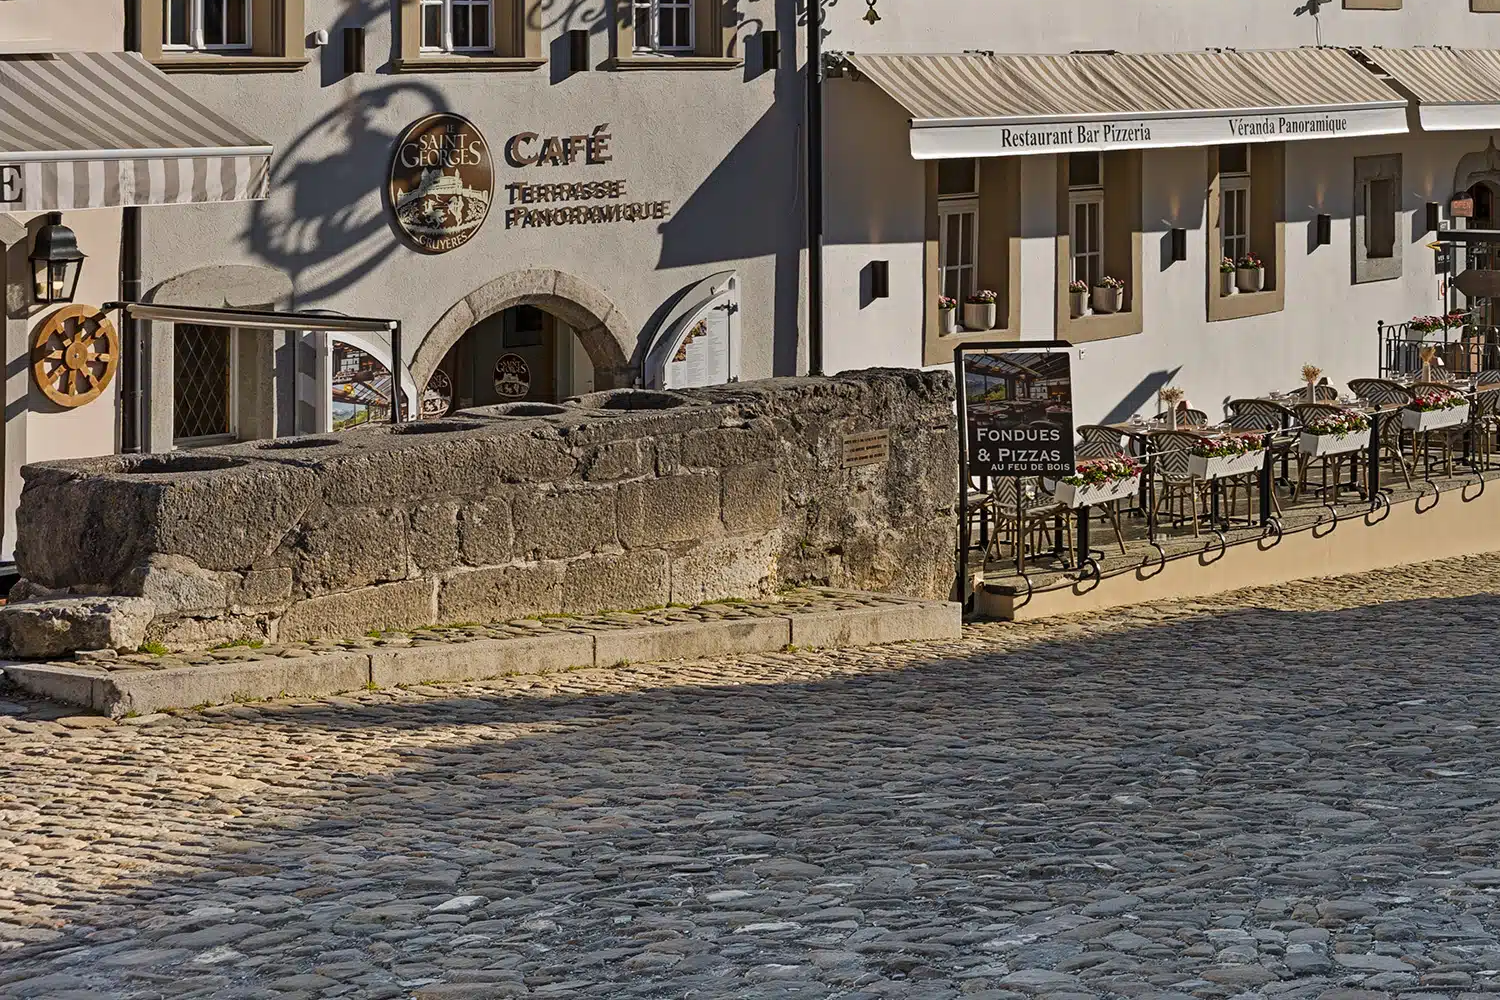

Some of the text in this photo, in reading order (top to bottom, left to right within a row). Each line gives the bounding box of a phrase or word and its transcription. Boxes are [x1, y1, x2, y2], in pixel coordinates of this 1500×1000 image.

[1001, 122, 1151, 148] Restaurant Bar Pizzeria
[1228, 115, 1347, 136] Véranda Panoramique
[419, 133, 468, 149] SAINT
[504, 123, 613, 168] CAFÉ
[401, 141, 481, 168] GEORGES
[504, 179, 627, 205] TERRASSE
[504, 200, 671, 230] PANORAMIQUE
[419, 233, 468, 250] GRUYÈRES
[977, 428, 1060, 442] FONDUES
[978, 448, 1061, 462] & PIZZAS
[1007, 463, 1027, 471] FEU
[1030, 463, 1043, 471] DE
[1047, 463, 1070, 471] BOIS
